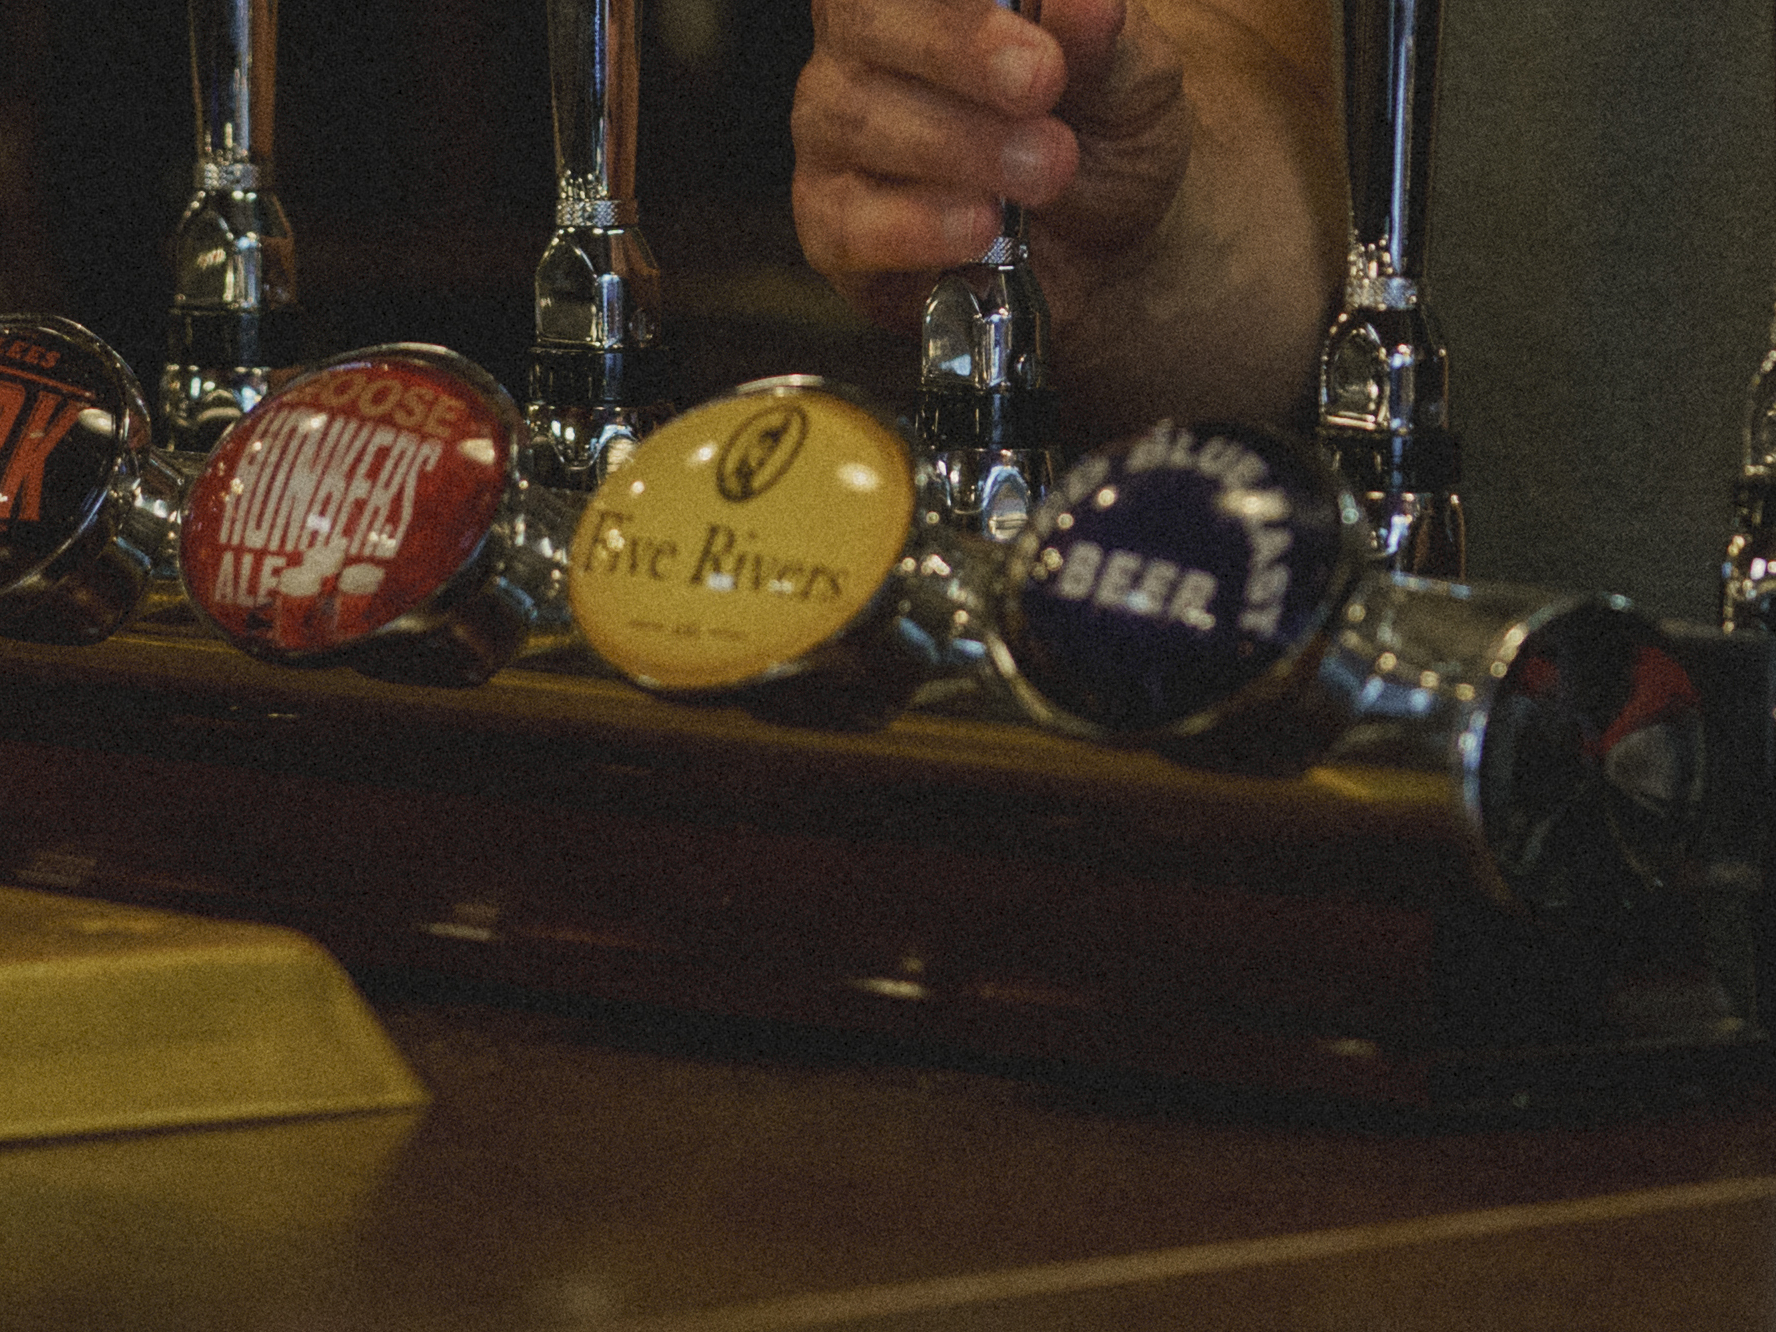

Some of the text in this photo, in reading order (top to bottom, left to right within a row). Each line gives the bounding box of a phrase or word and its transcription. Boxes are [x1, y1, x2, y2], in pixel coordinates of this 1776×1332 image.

[214, 549, 287, 608] ALE
[581, 510, 851, 602] Five Rivers
[1057, 540, 1219, 630] BEER
